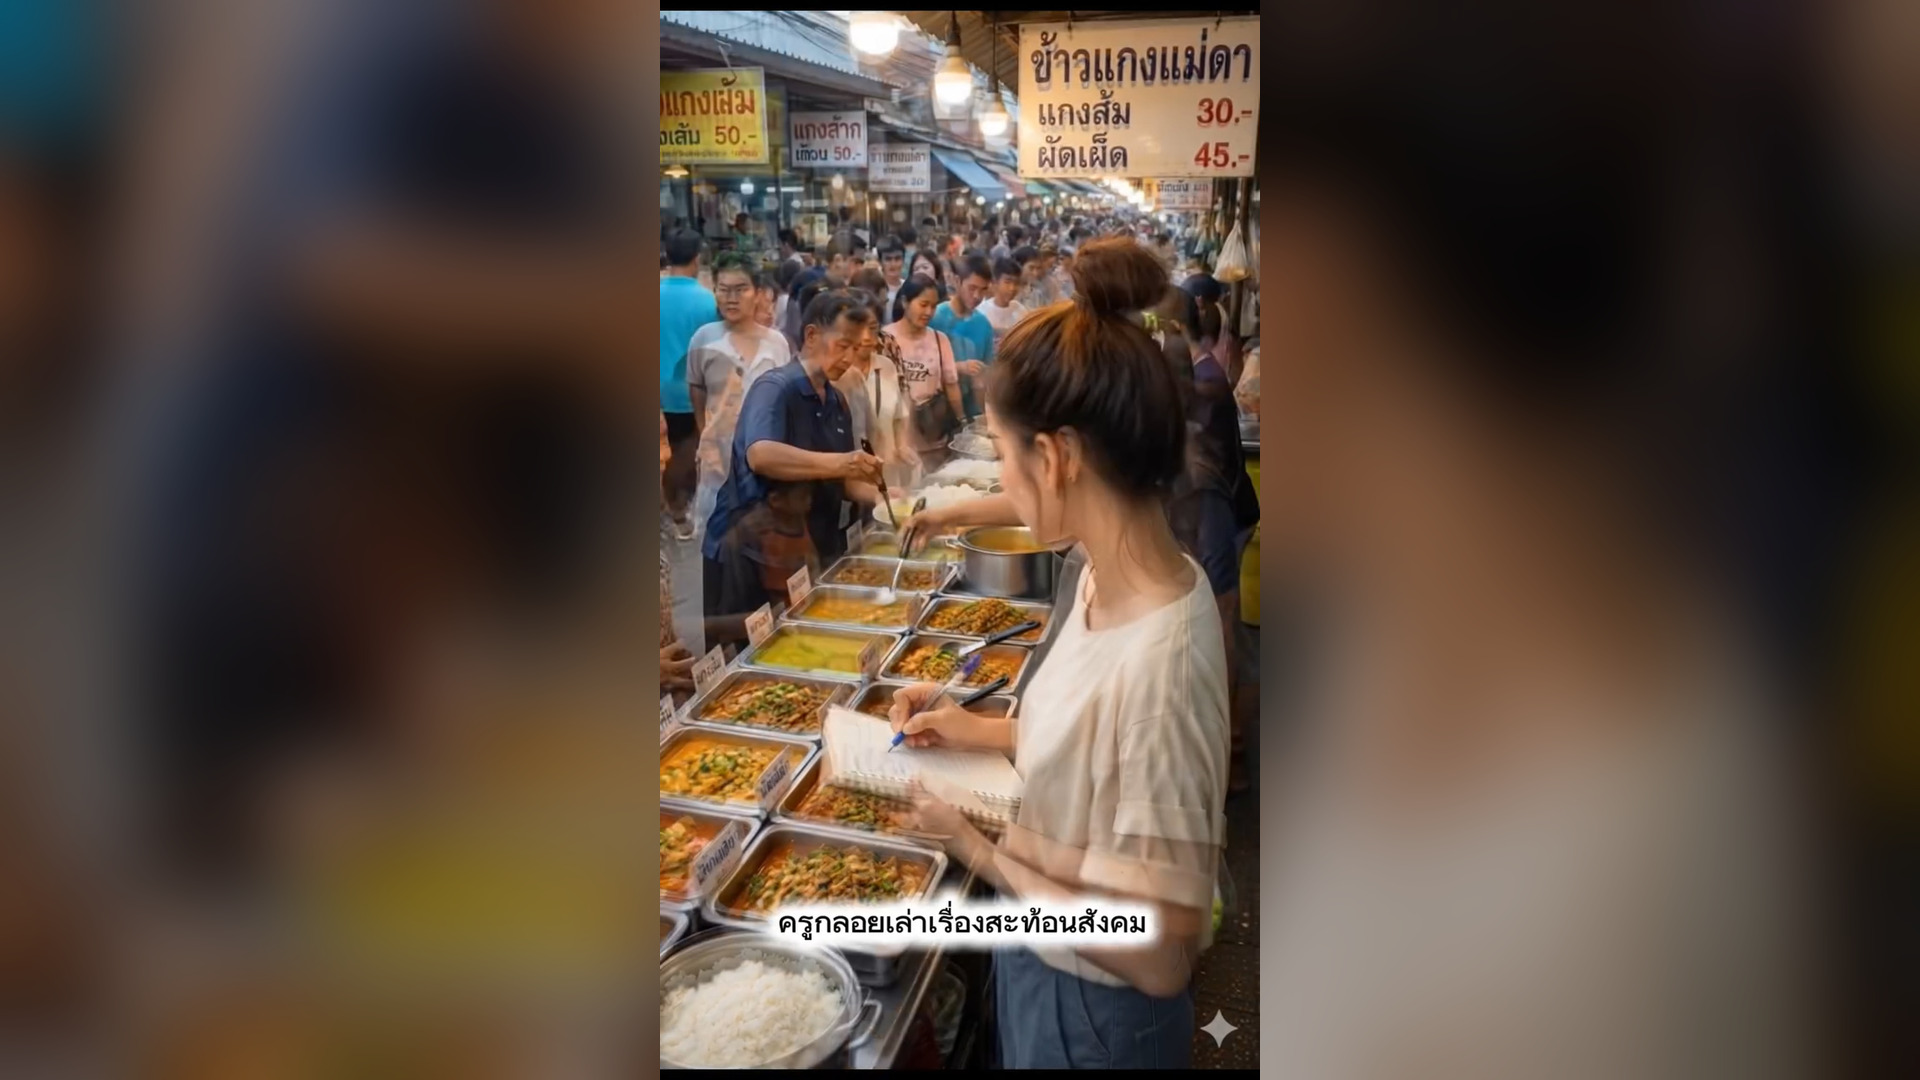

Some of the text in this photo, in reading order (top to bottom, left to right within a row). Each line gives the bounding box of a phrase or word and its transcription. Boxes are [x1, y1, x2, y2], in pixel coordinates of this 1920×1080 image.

[1031, 28, 1251, 85] ข้าวแกงแม่ดา
[660, 76, 755, 116] แกงเส้ม
[1038, 90, 1253, 127] แกงส้ม 30.-
[714, 125, 758, 146] 50.-
[1037, 131, 1250, 169] ผัดเผ็ด 45.-
